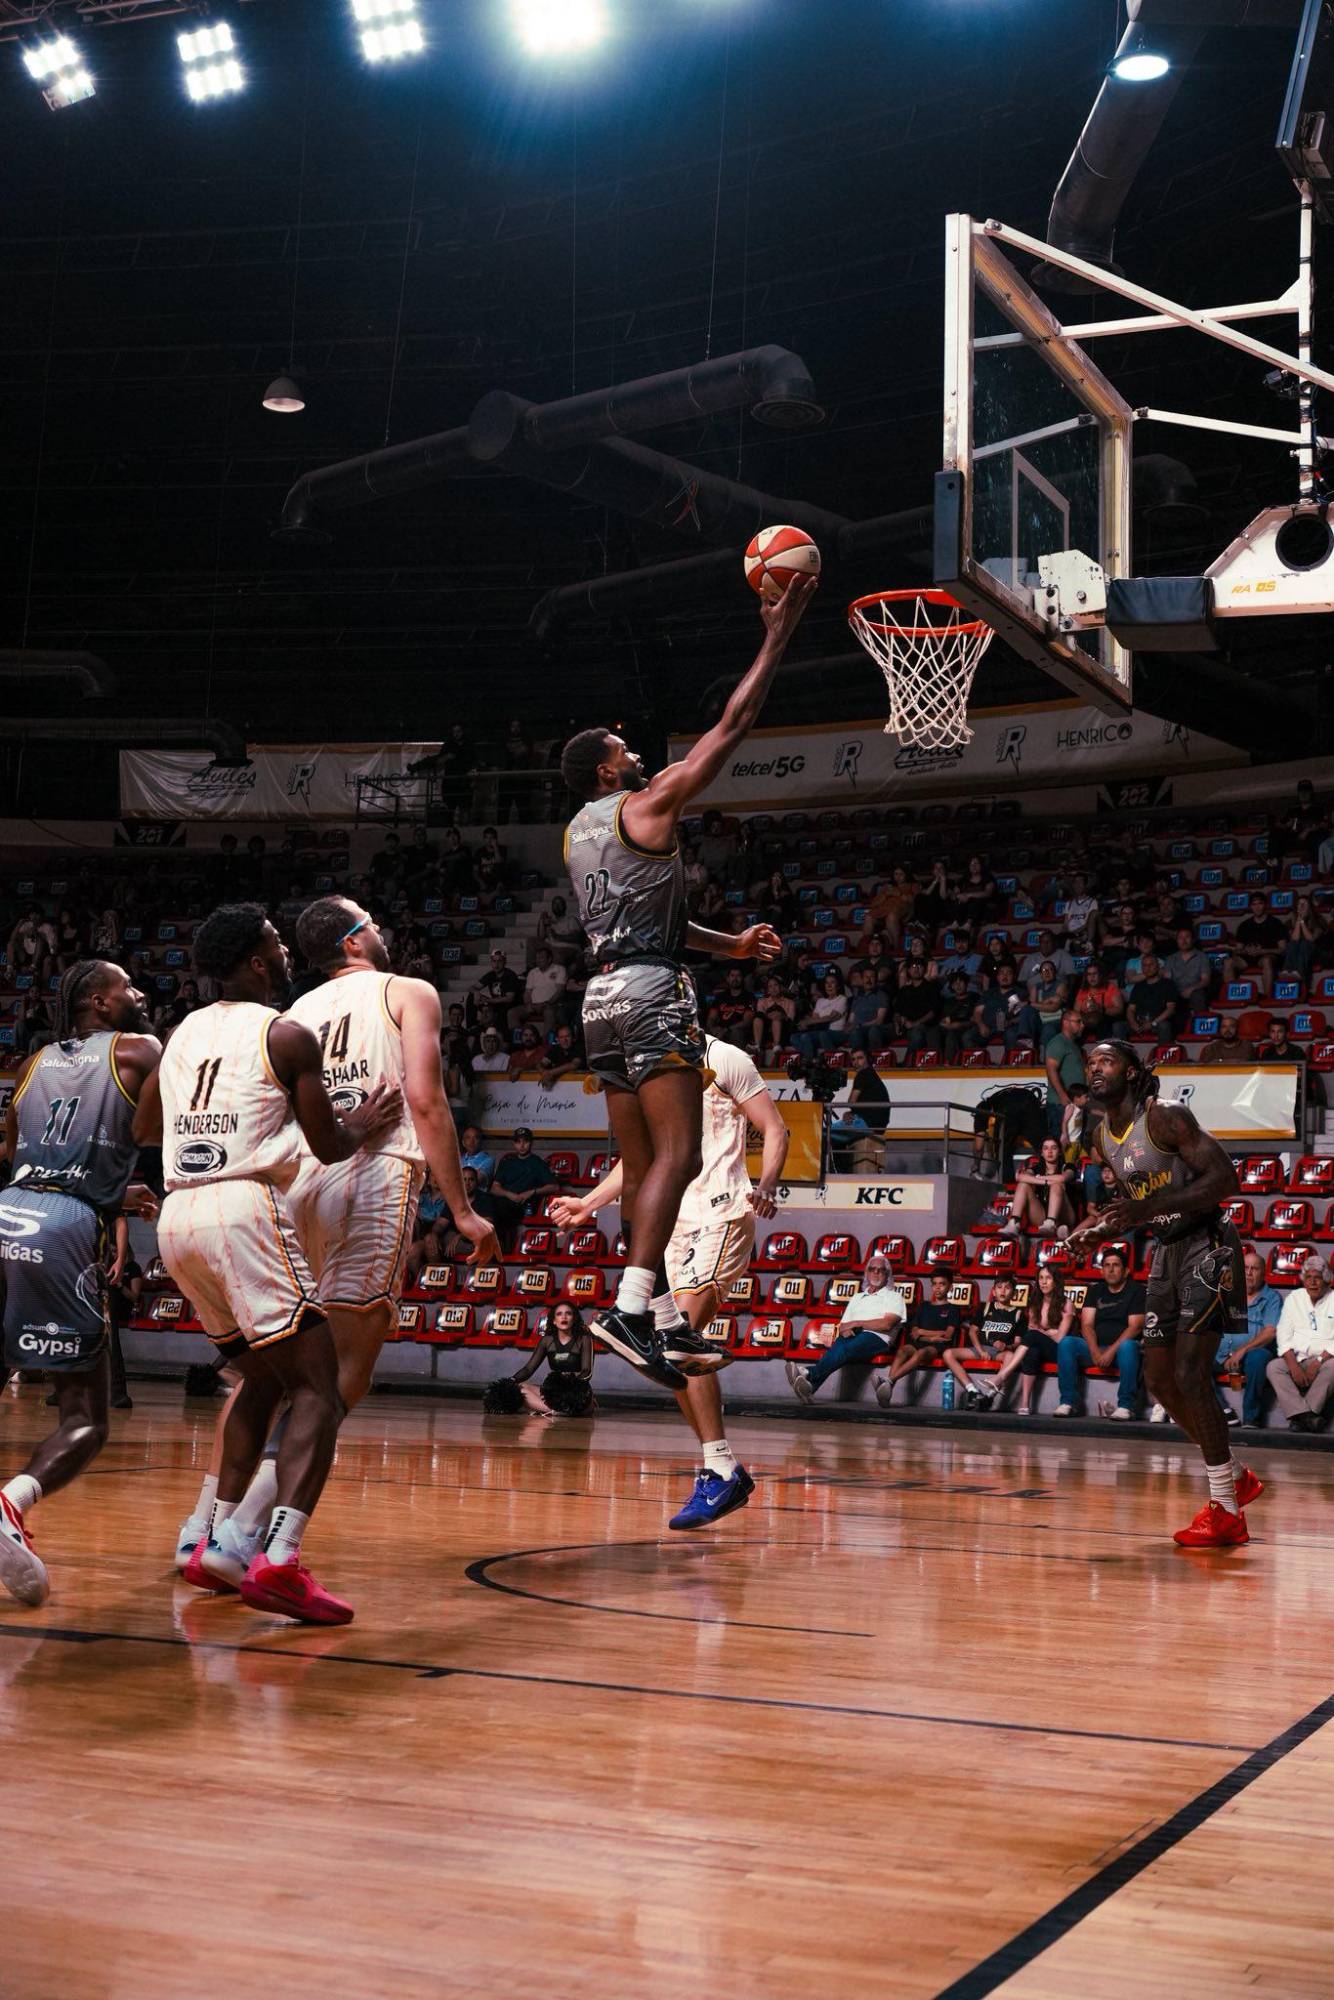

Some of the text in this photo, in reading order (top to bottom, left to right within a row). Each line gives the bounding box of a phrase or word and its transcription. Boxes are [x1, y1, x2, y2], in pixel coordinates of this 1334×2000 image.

[1057, 723, 1132, 747] HENRICO
[585, 868, 612, 919] 22
[318, 1013, 351, 1063] 14
[190, 1057, 222, 1111] 11
[40, 1096, 81, 1145] 11
[855, 1187, 904, 1205] KFC
[428, 1270, 446, 1282] 018
[478, 1271, 495, 1284] 017
[526, 1273, 543, 1286] 016
[575, 1278, 592, 1291] 015
[785, 1282, 800, 1295] 011
[836, 1284, 855, 1297] 010
[709, 1322, 723, 1336] 011
[984, 1320, 1011, 1332] RAYOS
[18, 1332, 82, 1355] Gypsi
